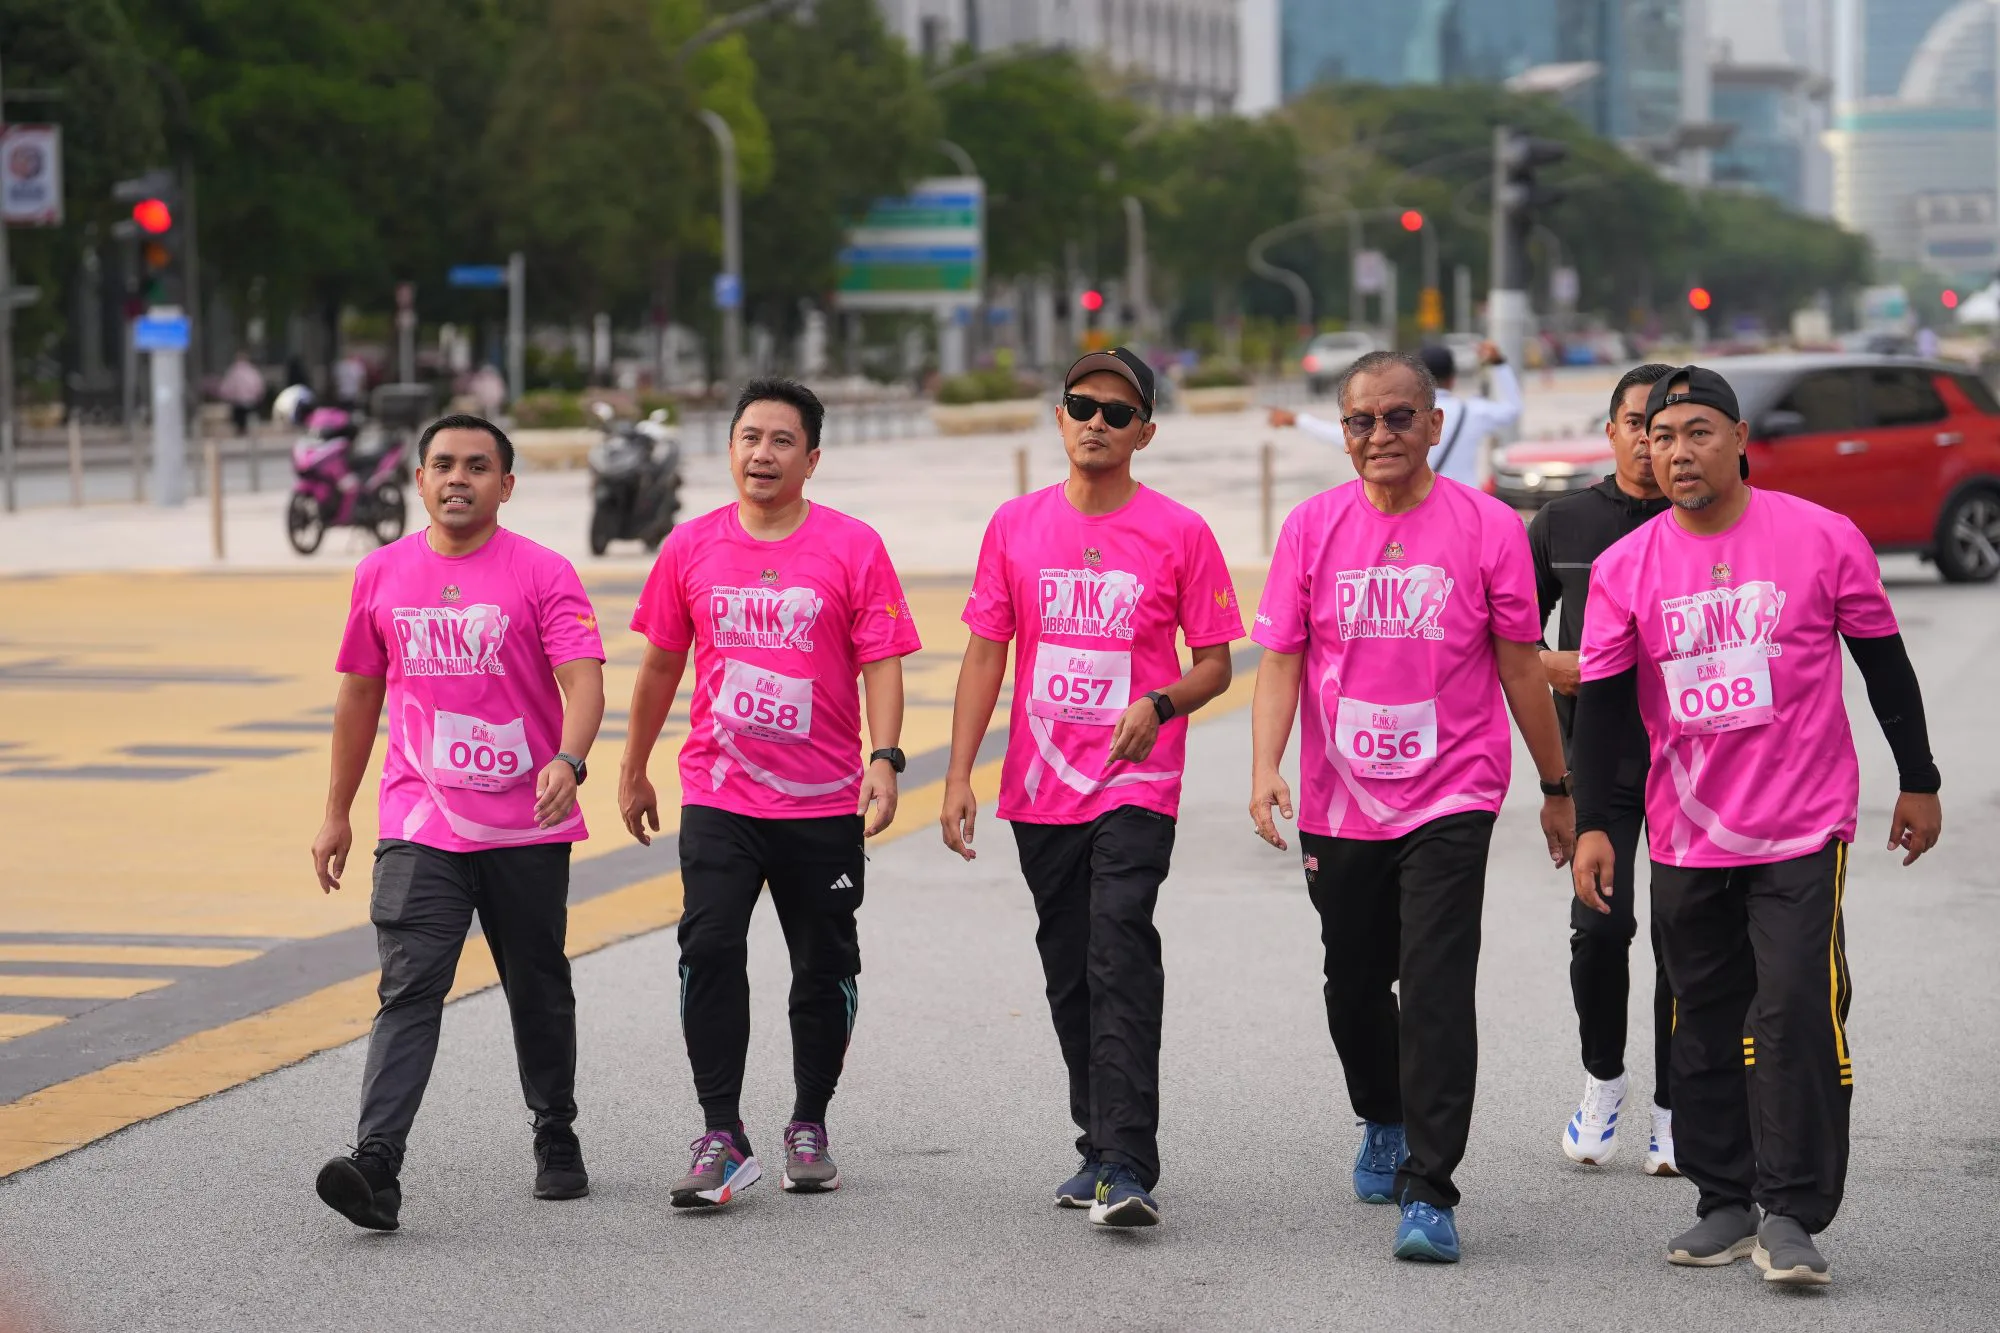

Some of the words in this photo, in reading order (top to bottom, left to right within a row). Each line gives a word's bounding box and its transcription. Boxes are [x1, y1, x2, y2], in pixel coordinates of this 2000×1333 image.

[715, 632, 755, 646] RIBBON
[758, 633, 781, 646] RUN
[1381, 620, 1405, 636] RUN
[1424, 628, 1443, 638] 2025
[1765, 645, 1780, 656] 025
[446, 658, 473, 674] RUN
[1047, 674, 1114, 706] 057
[1680, 677, 1755, 717] 008
[734, 691, 799, 730] 058
[1353, 730, 1421, 760] 056
[449, 741, 518, 775] 009
